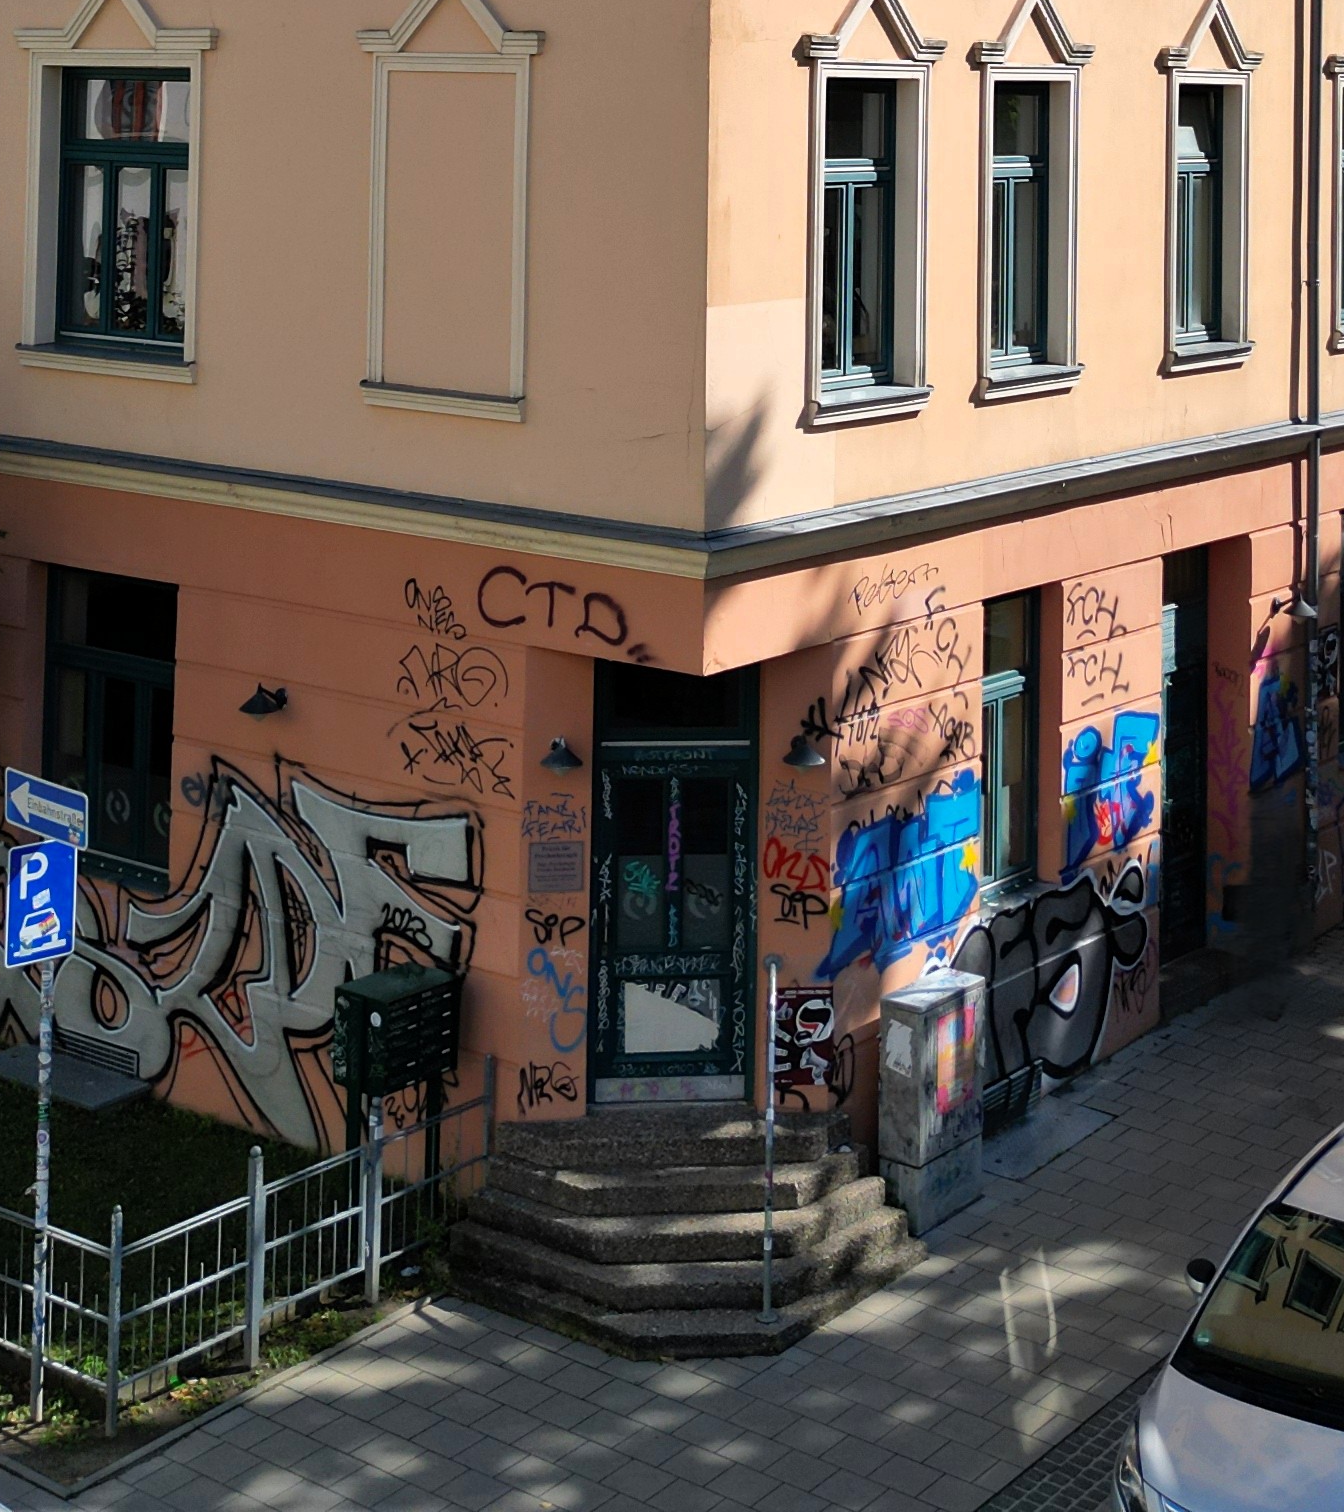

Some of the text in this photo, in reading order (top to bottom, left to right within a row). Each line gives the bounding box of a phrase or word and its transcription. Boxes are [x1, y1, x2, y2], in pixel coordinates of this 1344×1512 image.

[477, 565, 629, 647] CTD
[27, 796, 82, 827] Einbahnstraße
[19, 851, 49, 900] P
